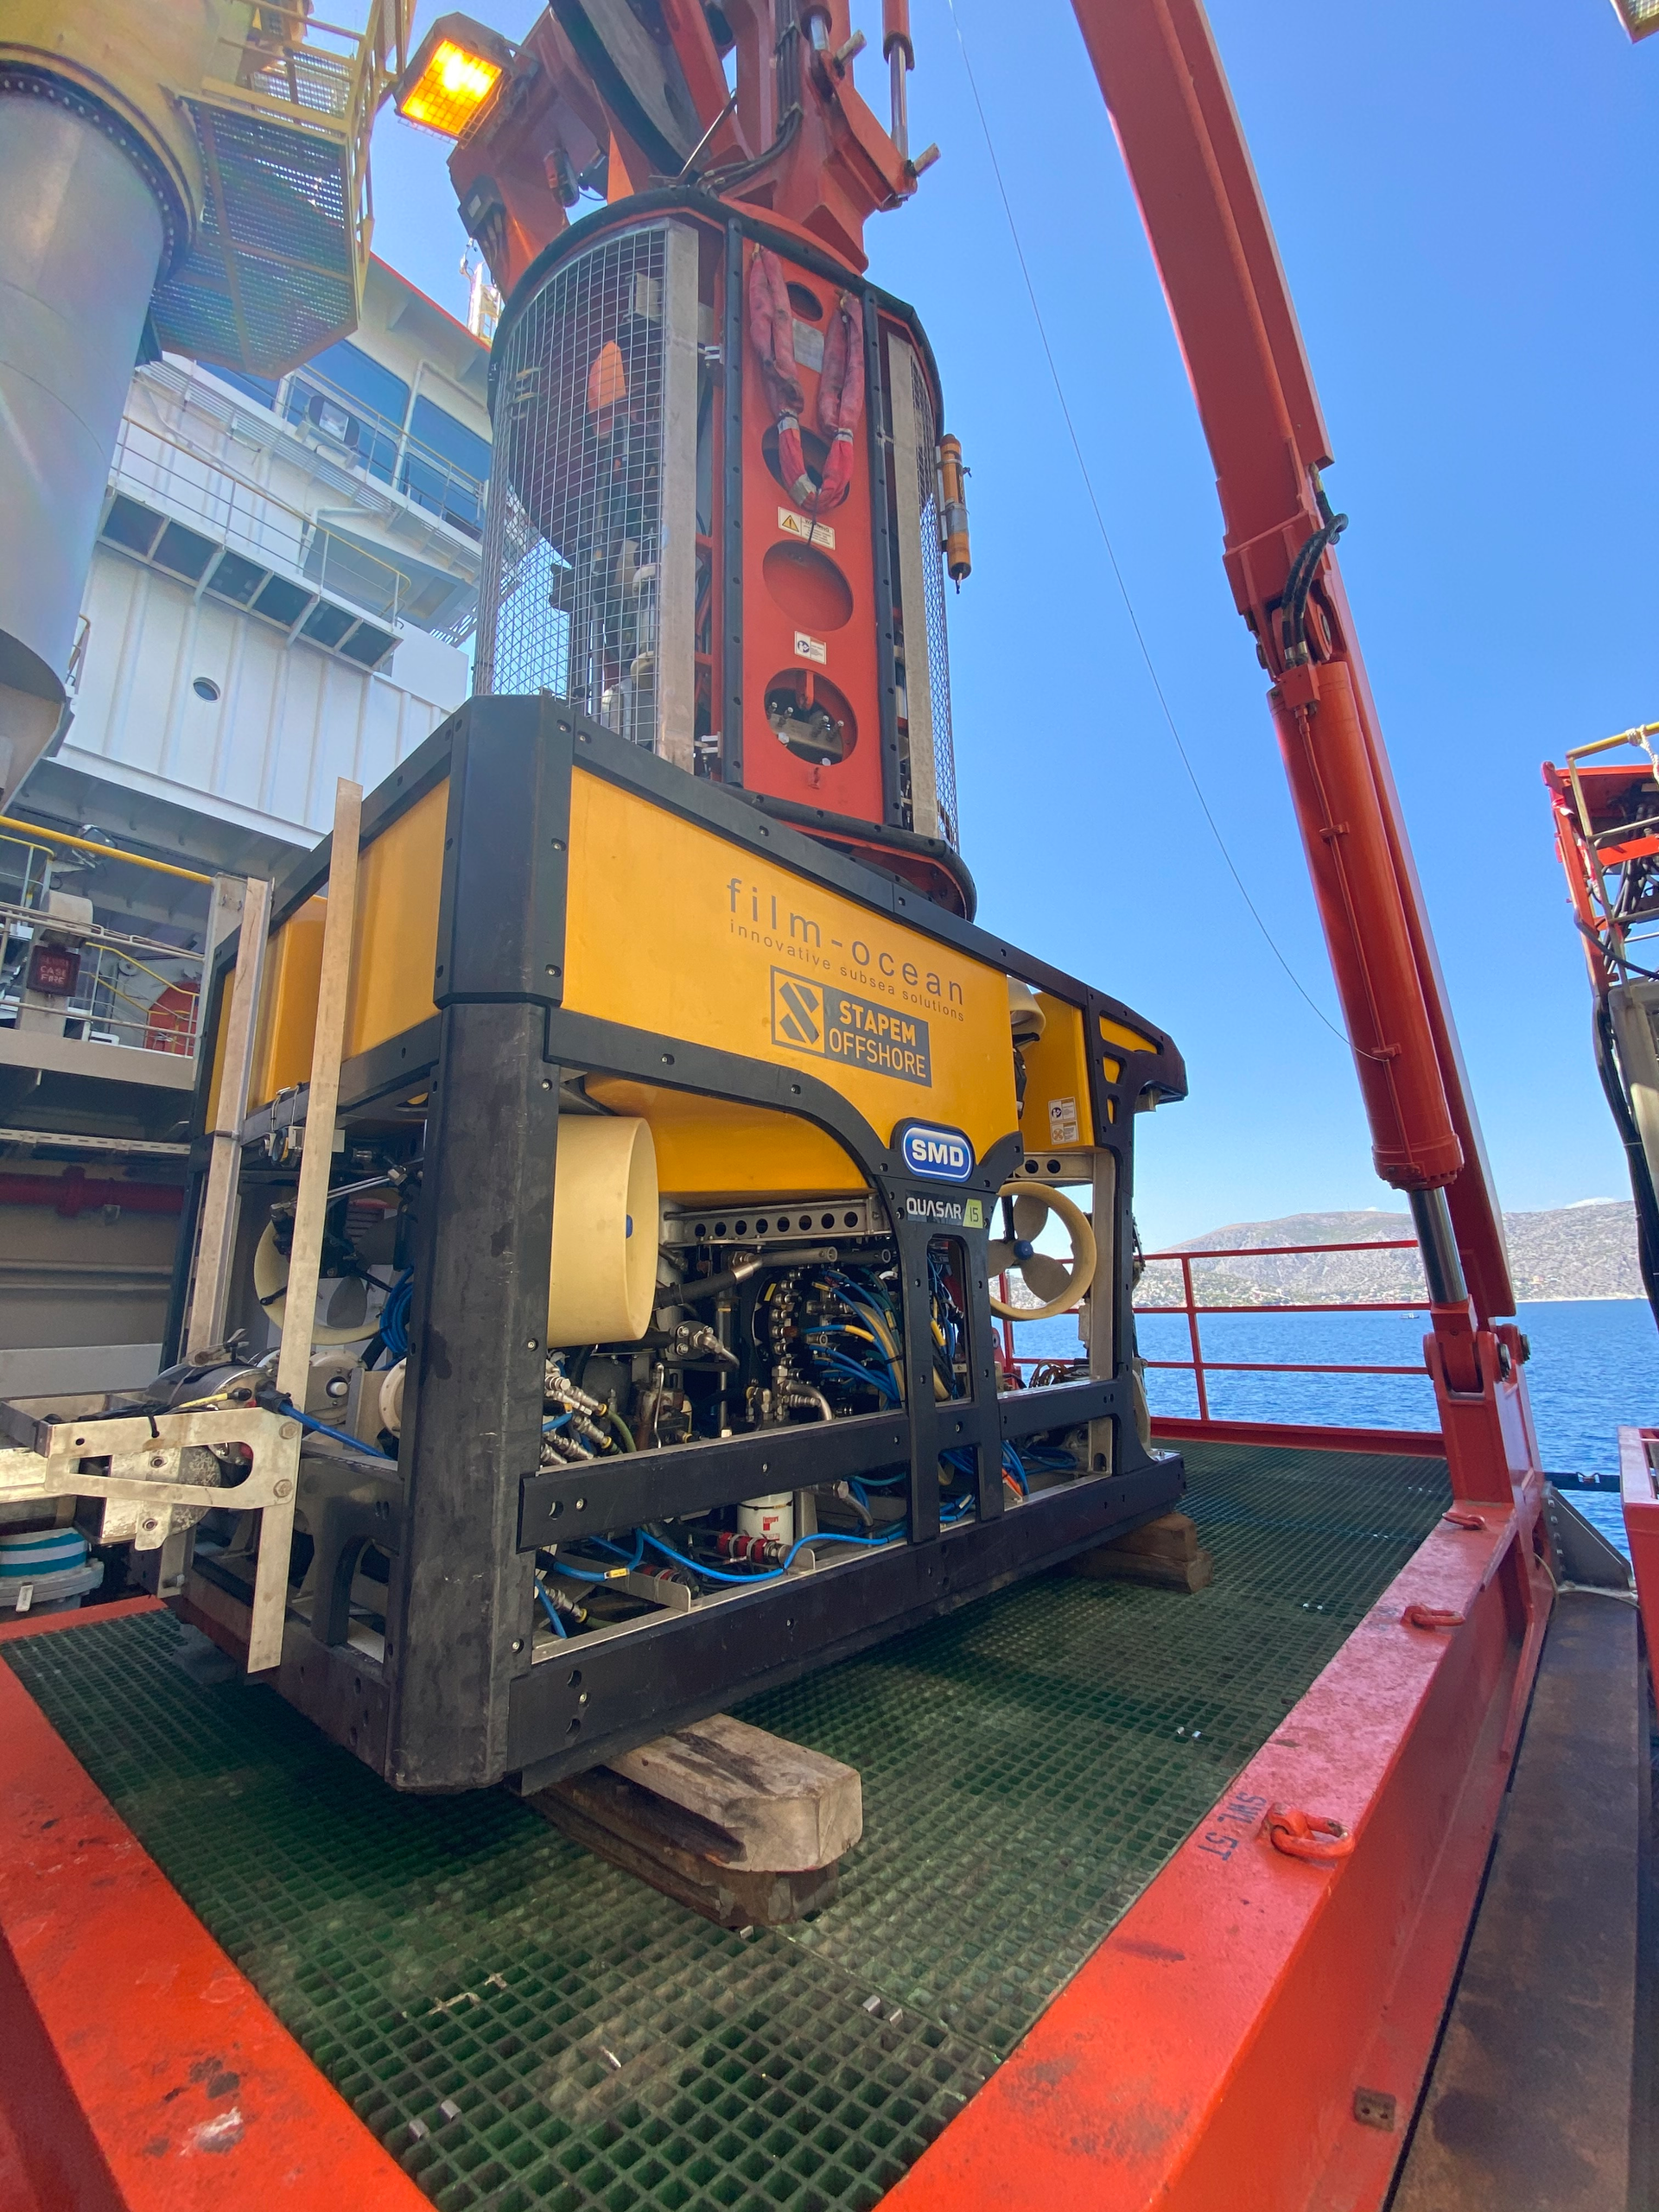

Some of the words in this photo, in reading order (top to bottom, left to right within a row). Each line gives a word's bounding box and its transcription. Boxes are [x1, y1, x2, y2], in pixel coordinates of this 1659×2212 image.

[727, 878, 963, 1006] film-ocean
[730, 919, 831, 970] innovative
[840, 966, 895, 995] subsea
[902, 990, 964, 1022] solutions
[839, 1000, 917, 1047] STAPEM
[829, 1028, 927, 1078] OFFSHORE
[912, 1139, 964, 1167] SMD
[906, 1197, 962, 1220] QUASAR
[969, 1206, 979, 1223] 15
